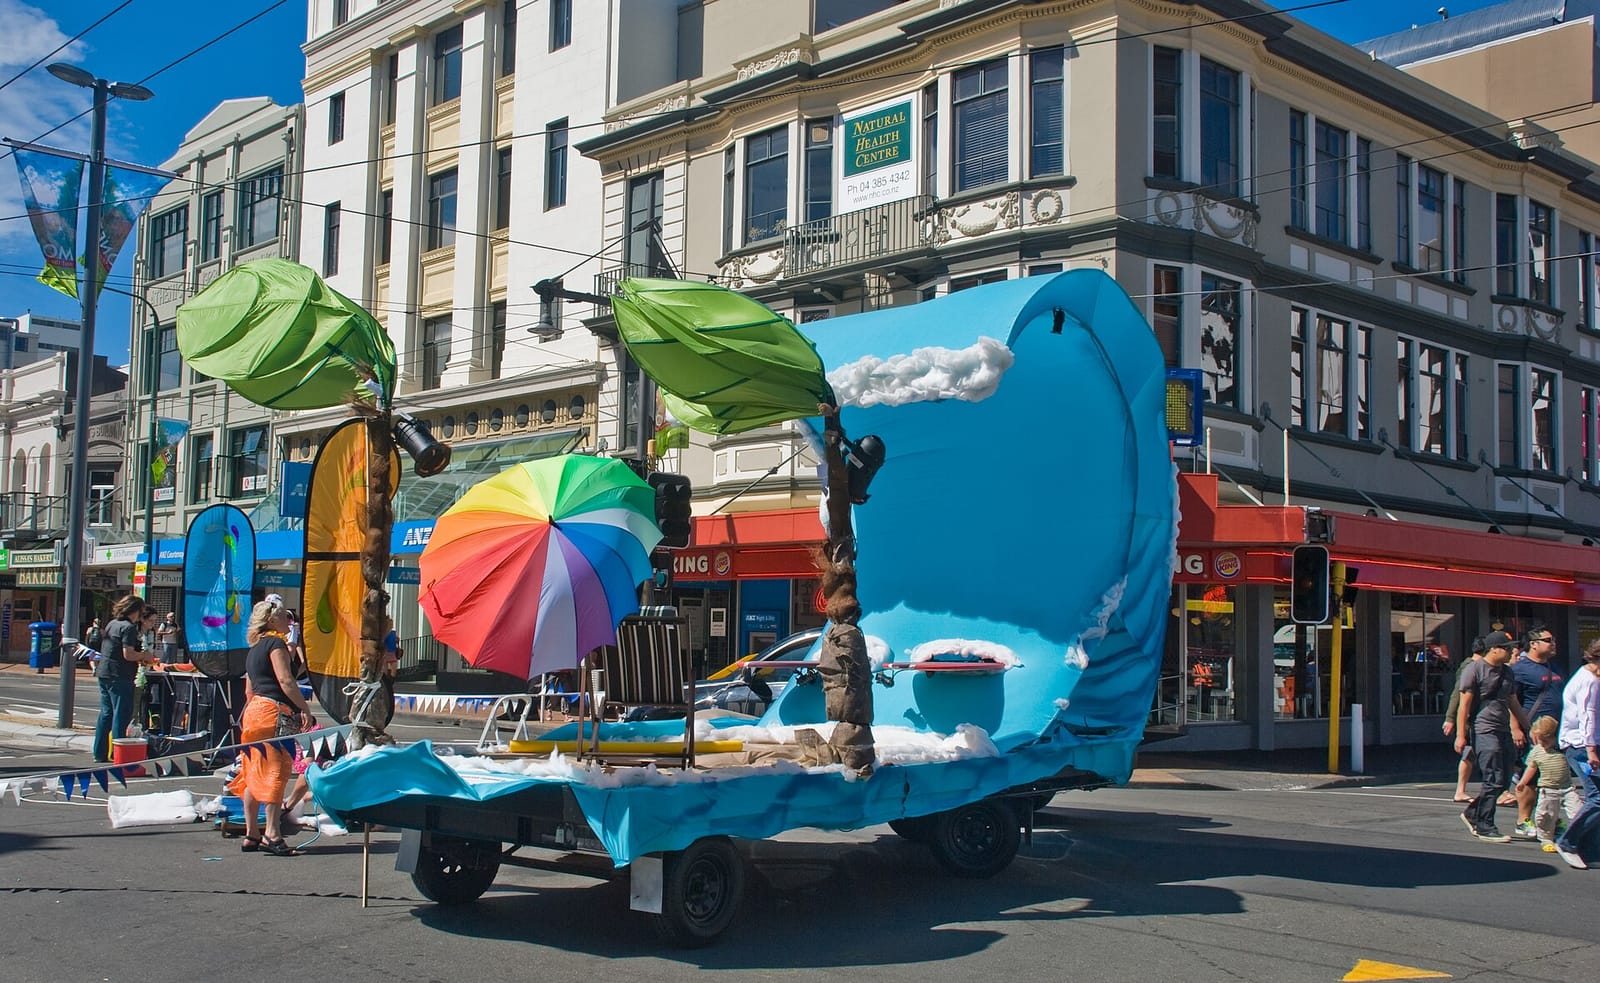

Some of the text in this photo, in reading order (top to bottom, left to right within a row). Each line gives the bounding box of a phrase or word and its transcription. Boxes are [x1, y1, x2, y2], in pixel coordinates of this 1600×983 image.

[853, 112, 905, 137] NATURAL
[856, 130, 899, 152] HEALTH
[856, 146, 899, 167] CENTRE
[847, 170, 910, 195] Ph 04 385 4342
[402, 527, 433, 546] ANZ
[18, 567, 60, 585] BAKERY
[1220, 562, 1238, 571] KING
